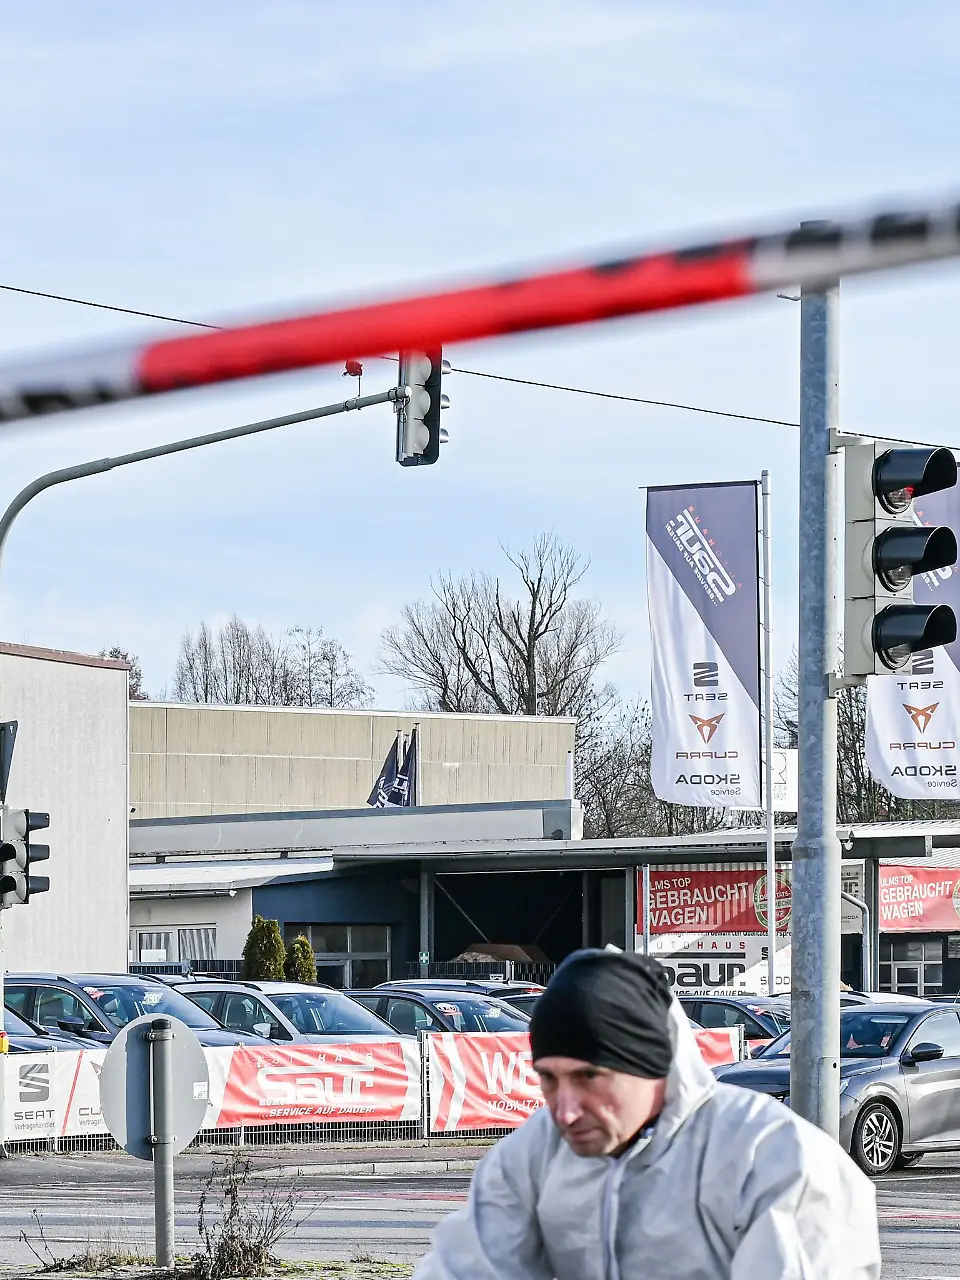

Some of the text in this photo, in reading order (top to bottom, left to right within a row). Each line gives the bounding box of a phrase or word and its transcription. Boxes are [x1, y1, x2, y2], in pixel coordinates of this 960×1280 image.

[649, 877, 691, 892] LMS TOP
[900, 874, 914, 884] TOP
[881, 880, 953, 904] GEBRAUCHT
[881, 901, 924, 921] WAGEN
[14, 1109, 55, 1120] SEAT
[314, 1106, 337, 1115] AUF
